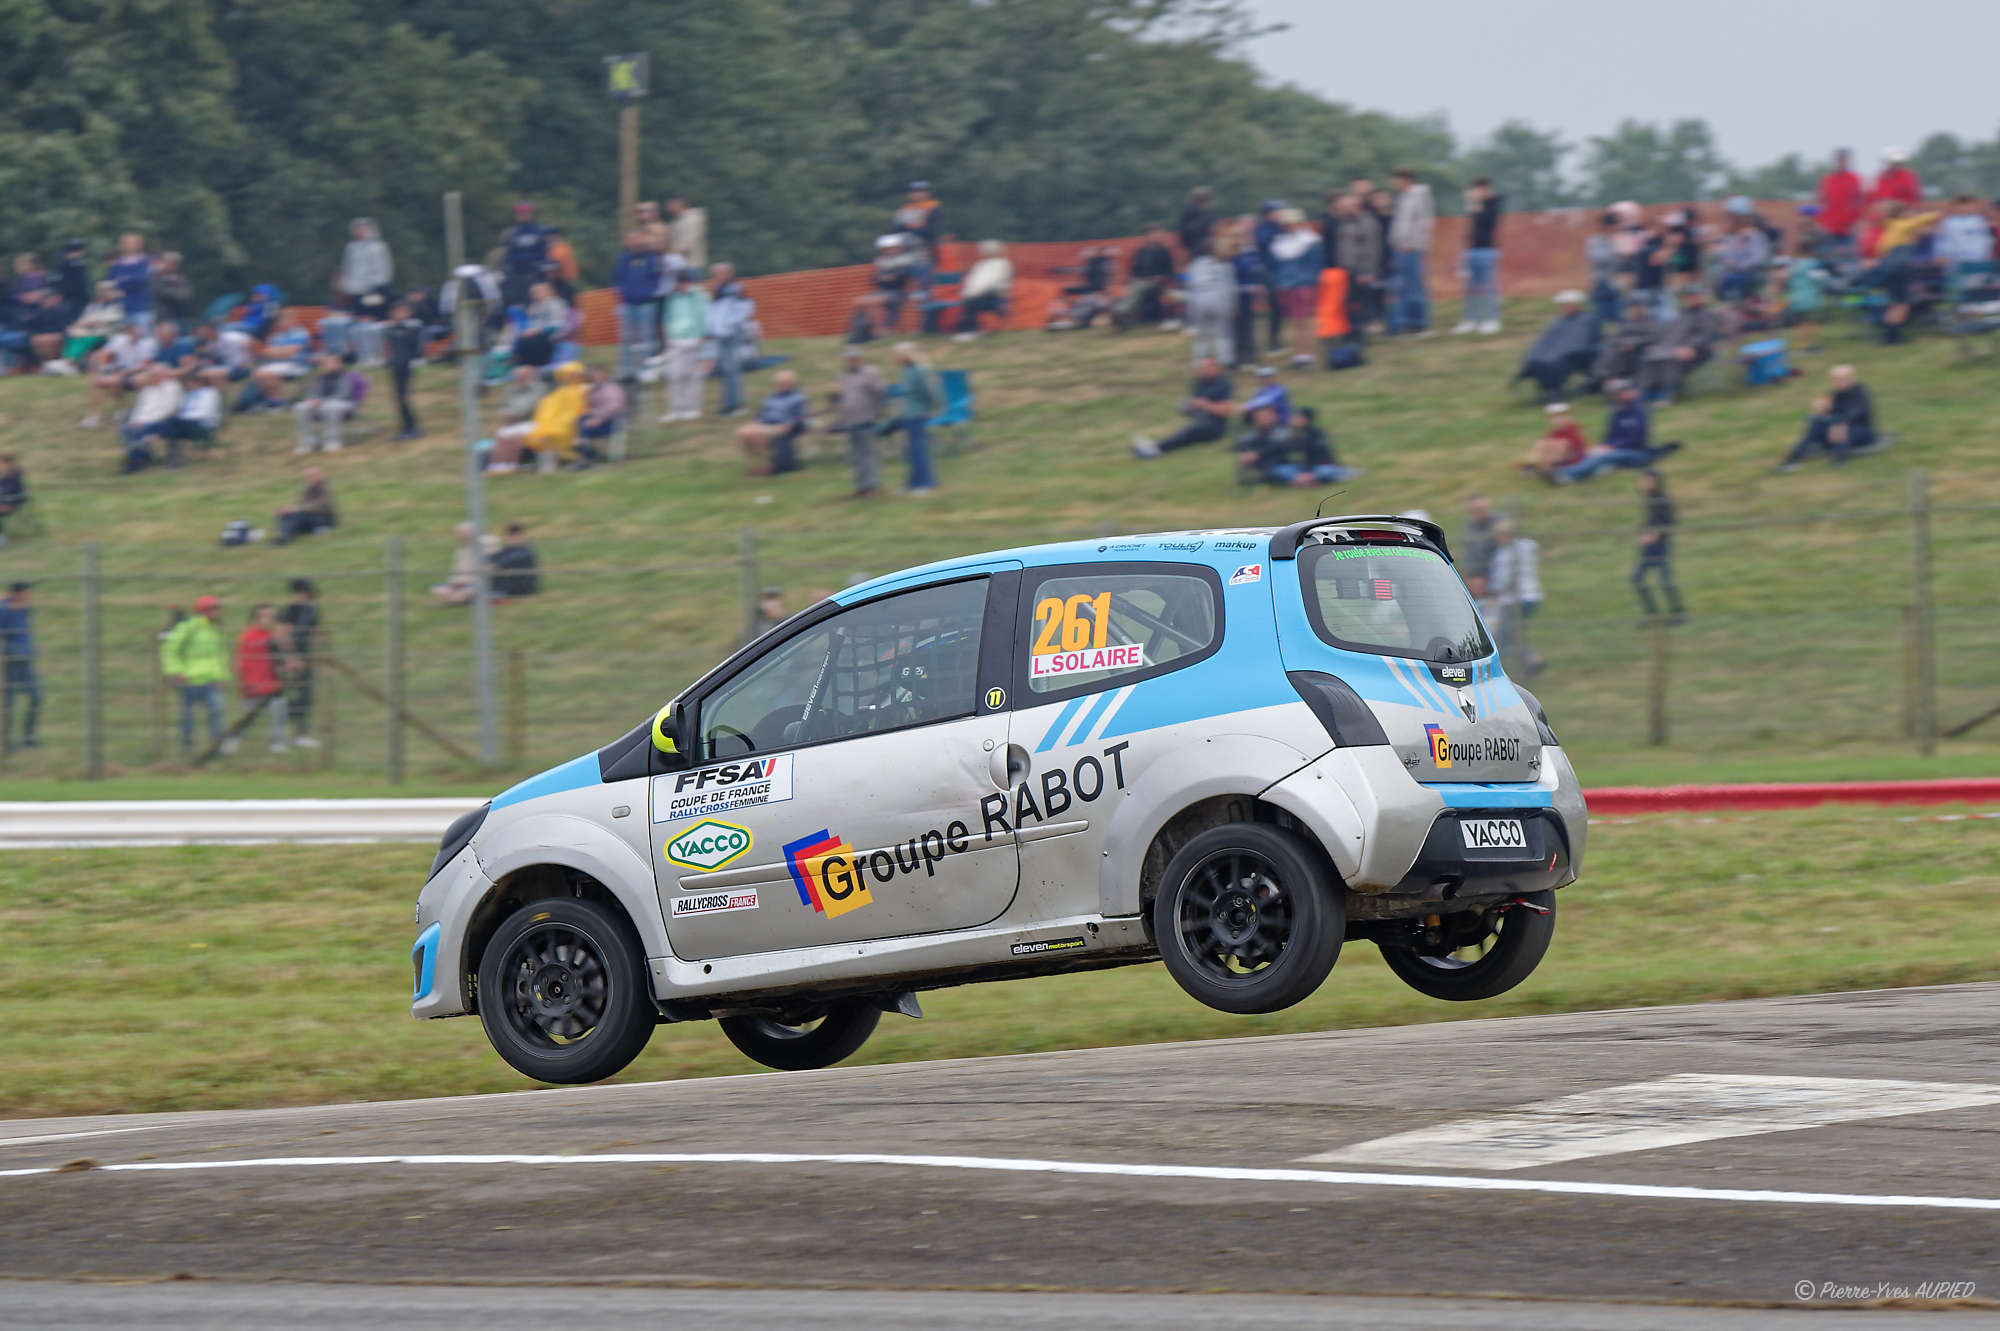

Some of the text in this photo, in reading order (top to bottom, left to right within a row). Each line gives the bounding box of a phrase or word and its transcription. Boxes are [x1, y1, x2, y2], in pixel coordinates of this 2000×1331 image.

[1214, 541, 1257, 551] markup
[1032, 591, 1111, 656] 261
[1034, 646, 1140, 675] L.SOLAIRE
[1441, 666, 1466, 678] eleven
[1438, 737, 1520, 768] Groupe RABOT
[674, 761, 763, 793] FFSA
[670, 783, 771, 810] COUPE DE FRANCE
[821, 740, 1129, 902] Groupe RABOT
[1465, 820, 1521, 847] YACCO
[676, 833, 743, 858] YACCO
[677, 894, 729, 913] RALLYCROSS
[1013, 943, 1049, 954] eleven
